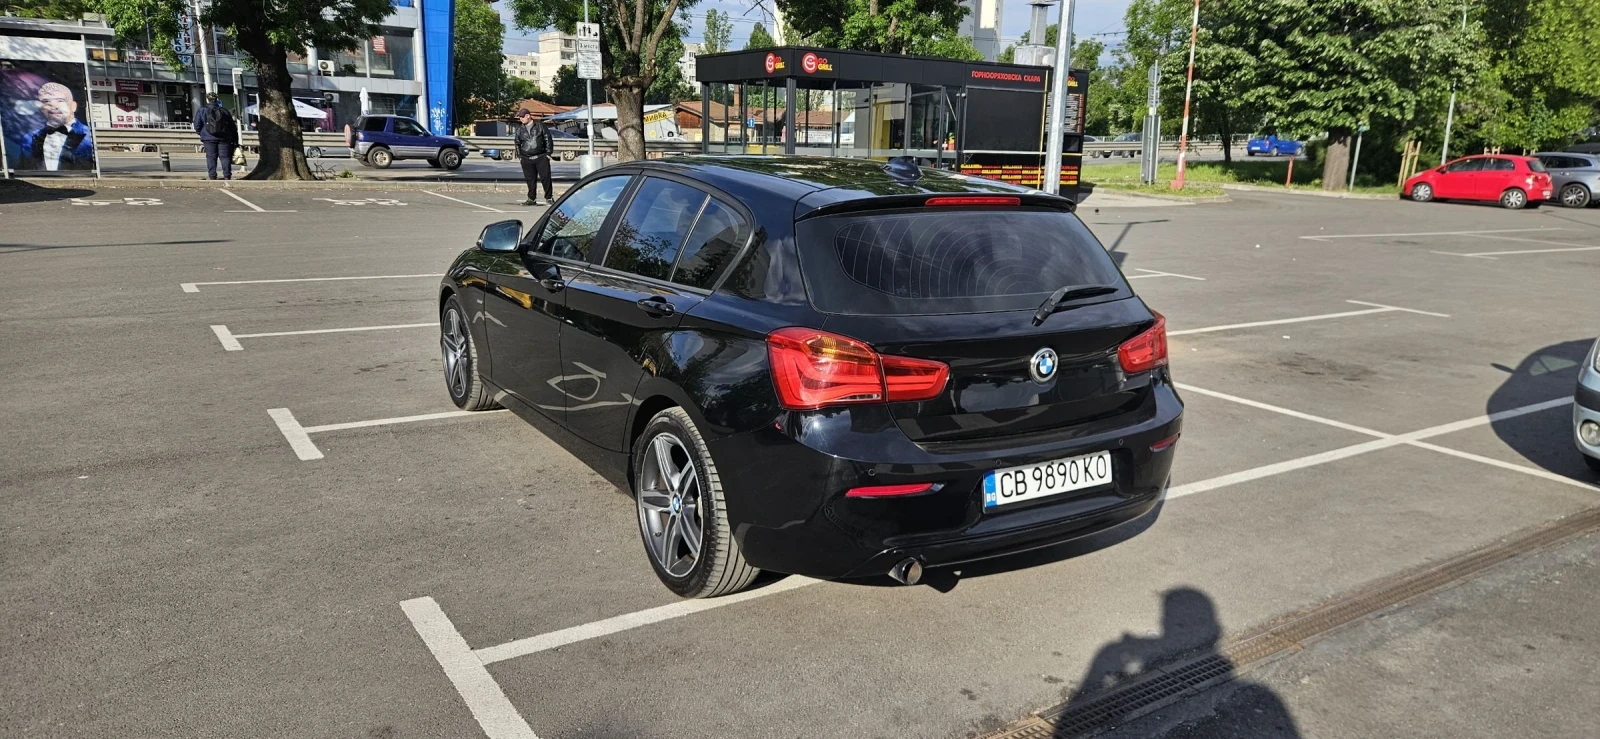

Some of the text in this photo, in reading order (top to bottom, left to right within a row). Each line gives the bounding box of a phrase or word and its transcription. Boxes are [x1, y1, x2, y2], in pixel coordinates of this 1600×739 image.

[818, 63, 833, 71] GRILL
[1023, 74, 1041, 83] СКАРА
[117, 96, 129, 104] IP
[1000, 455, 1107, 498] CB 9890 KO
[986, 493, 996, 502] BG
